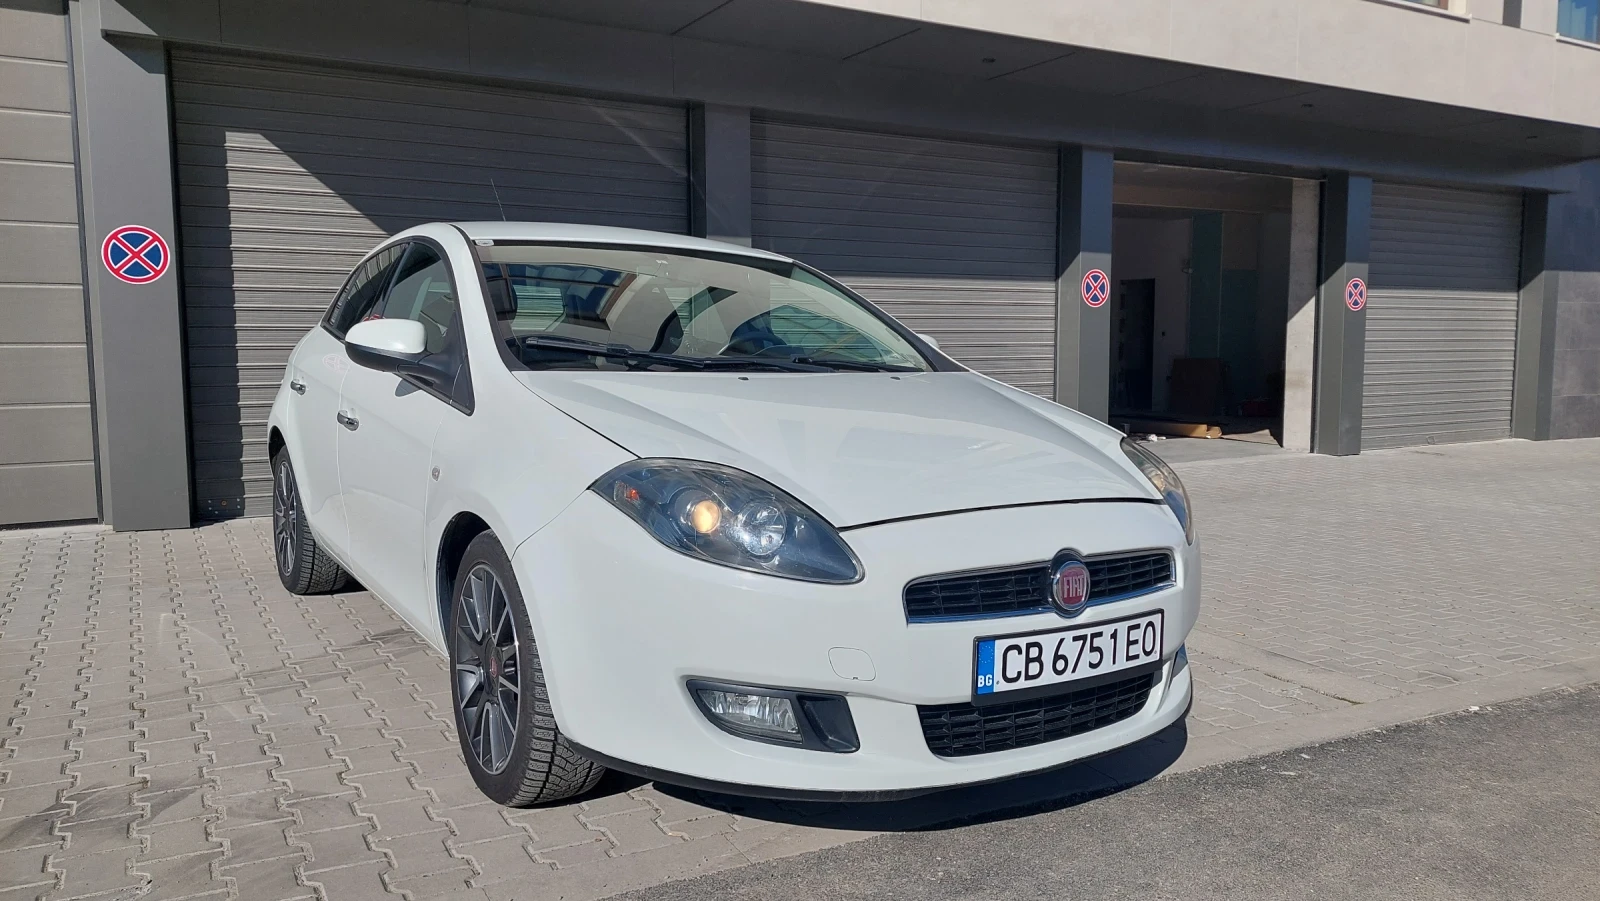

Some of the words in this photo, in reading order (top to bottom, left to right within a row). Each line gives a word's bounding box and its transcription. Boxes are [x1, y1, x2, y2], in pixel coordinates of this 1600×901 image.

[1063, 575, 1085, 598] FIAT
[1001, 641, 1044, 684] CB
[1051, 628, 1118, 676] 6751
[977, 674, 993, 688] BG
